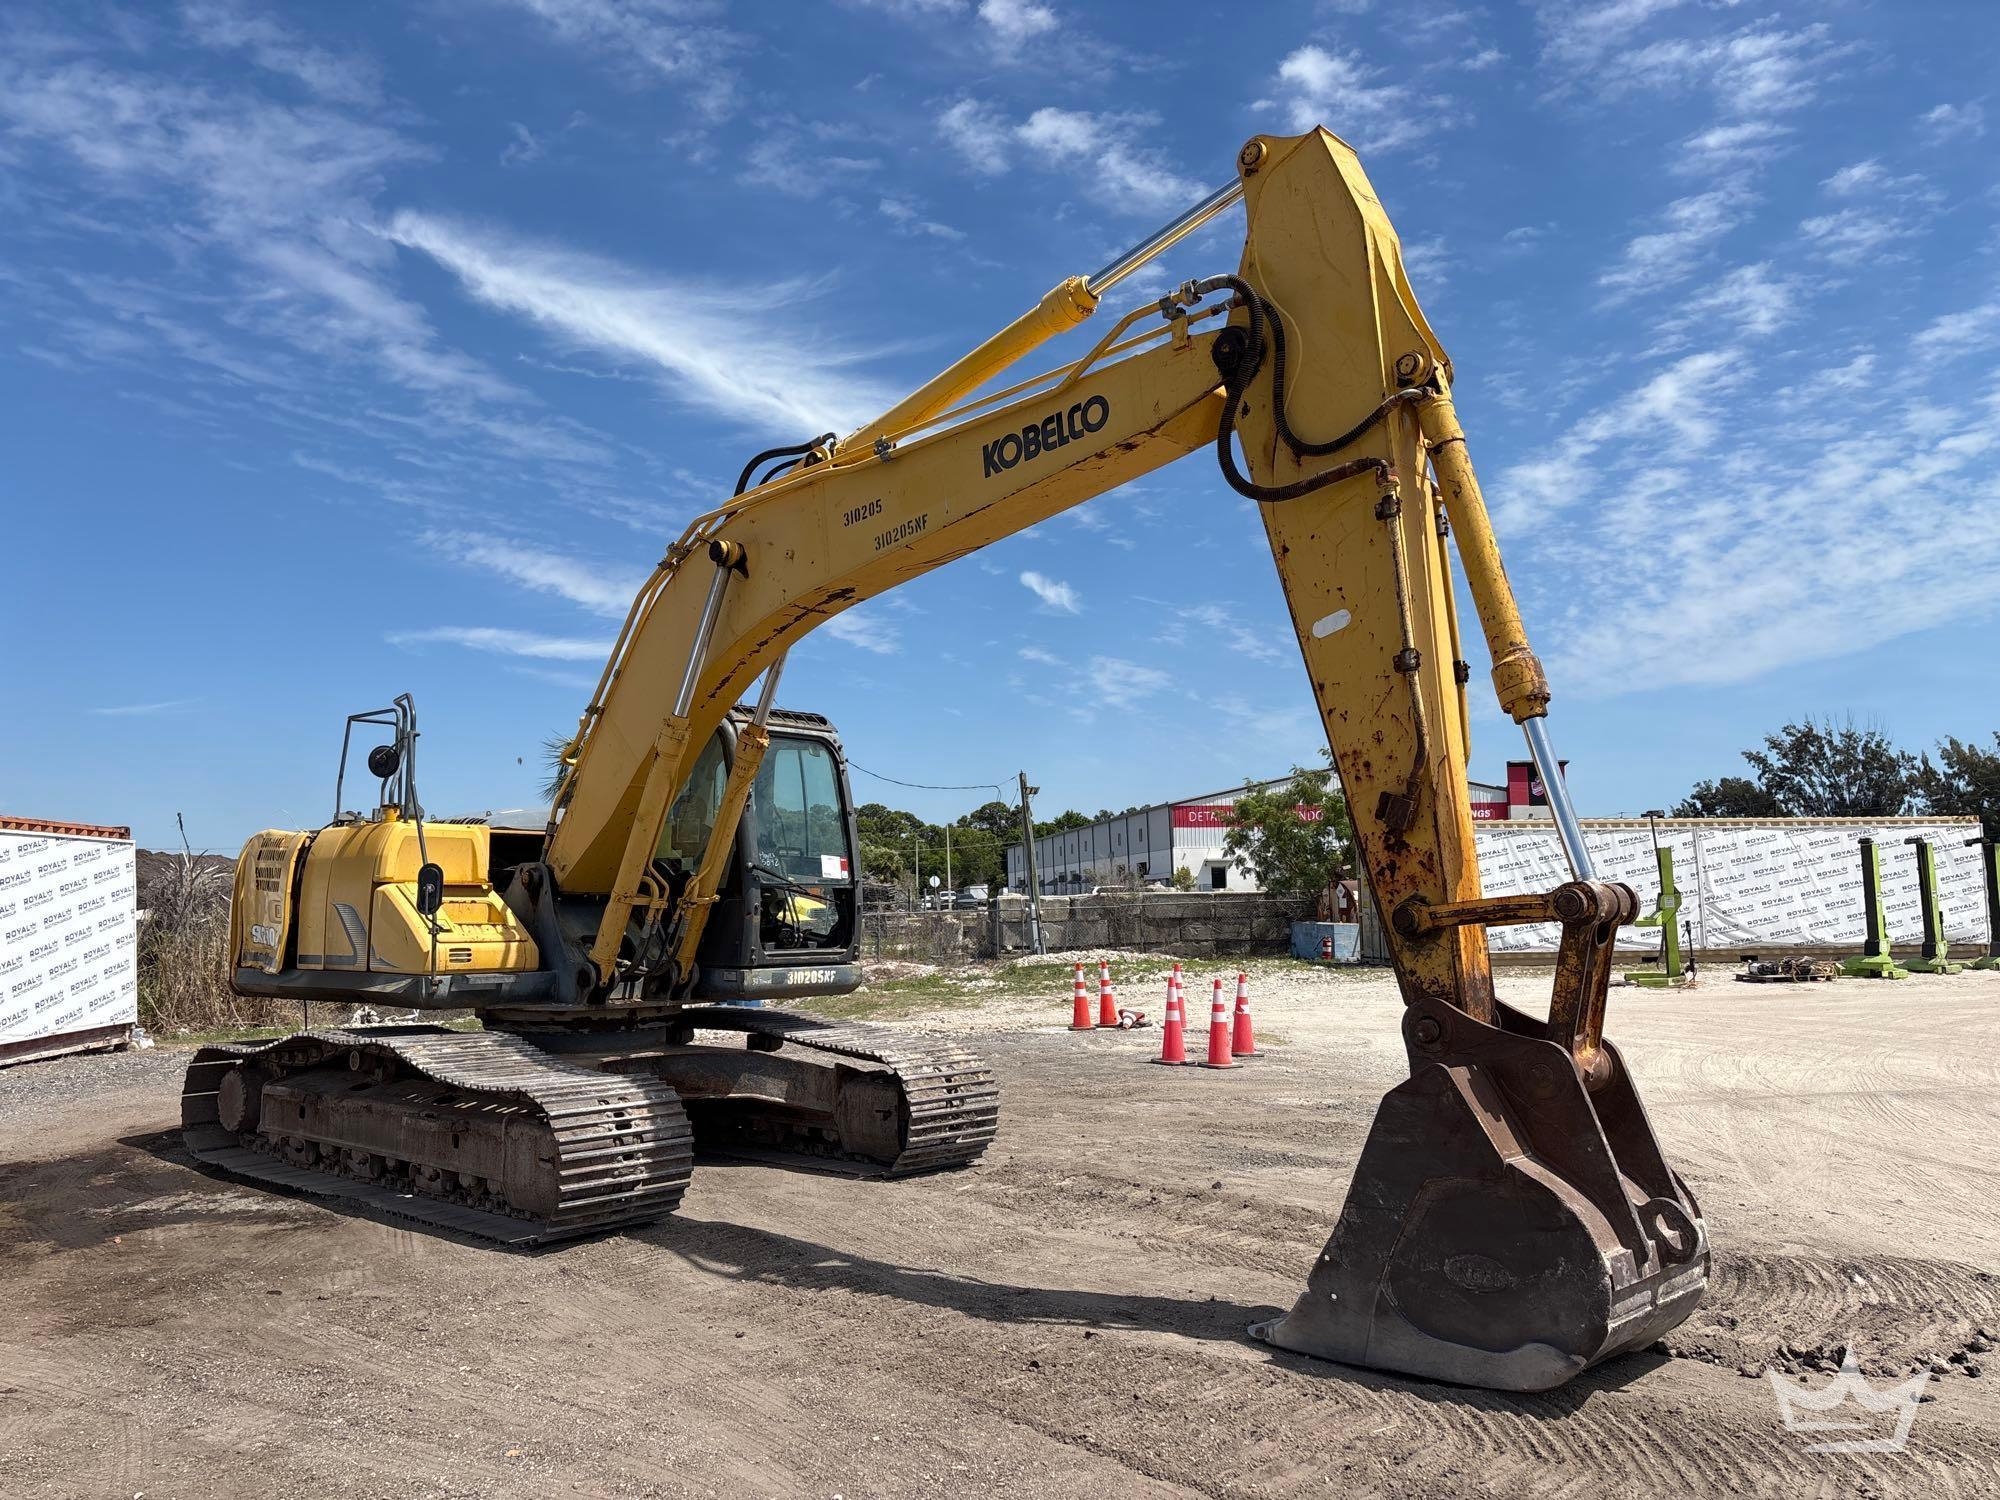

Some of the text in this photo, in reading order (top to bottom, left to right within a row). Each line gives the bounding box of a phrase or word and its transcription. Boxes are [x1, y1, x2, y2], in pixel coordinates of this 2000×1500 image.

[982, 395, 1110, 479] KOBELCO
[843, 498, 882, 527] 310205
[874, 513, 928, 550] 310205NF
[1847, 829, 1871, 838] ROYAL
[1618, 835, 1642, 844] ROYAL
[1745, 836, 1768, 845] ROYAL
[1809, 837, 1831, 846] ROYAL
[18, 840, 42, 852] ROYAL
[1516, 841, 1540, 850] ROYAL
[1706, 844, 1729, 853] ROYAL
[1770, 846, 1793, 855] ROYAL
[1830, 849, 1857, 858] ROYAL
[74, 850, 95, 861] ROYAL
[1539, 853, 1564, 862] ROYAL
[1603, 855, 1628, 864] ROYAL
[1731, 855, 1755, 863] ROYAL
[1954, 854, 1977, 863] ROYAL
[1498, 861, 1522, 870] ROYAL
[1793, 857, 1815, 866] ROYAL
[38, 861, 61, 873] ROYAL
[1626, 866, 1649, 875] ROYAL
[1753, 866, 1777, 875] ROYAL
[94, 868, 115, 880] ROYAL
[1523, 872, 1548, 881] ROYAL
[1817, 867, 1841, 877] ROYAL
[1941, 872, 1963, 881] ROYAL
[1714, 875, 1738, 884] ROYAL
[1779, 877, 1801, 886] ROYAL
[60, 879, 81, 892] ROYAL
[1484, 881, 1508, 889] ROYAL
[1739, 886, 1763, 894] ROYAL
[1801, 889, 1823, 897] ROYAL
[24, 891, 46, 905] ROYAL
[1761, 897, 1785, 905] ROYAL
[78, 900, 100, 911] ROYAL
[1825, 899, 1848, 908] ROYAL
[1886, 902, 1910, 910] ROYAL
[1949, 904, 1972, 912] ROYAL
[1722, 906, 1746, 915] ROYAL
[1787, 908, 1810, 917] ROYAL
[44, 913, 66, 925] ROYAL
[98, 916, 119, 928] ROYAL
[1748, 917, 1771, 925] ROYAL
[1809, 920, 1831, 928] ROYAL
[6, 926, 30, 939] ROYAL
[65, 929, 86, 942] ROYAL
[1641, 929, 1661, 938] ROYA
[1770, 928, 1793, 937] ROYAL
[1833, 929, 1858, 939] ROYAL
[1895, 932, 1920, 941] ROYAL
[30, 945, 52, 957] ROYAL
[84, 947, 104, 960] ROYAL
[49, 962, 71, 975] ROYAL
[104, 963, 124, 975] ROYAL
[12, 979, 36, 992] ROYAL
[71, 978, 92, 992] ROYAL
[35, 994, 58, 1009] ROYAL
[89, 994, 111, 1008] ROYAL
[55, 1012, 76, 1025] ROYAL
